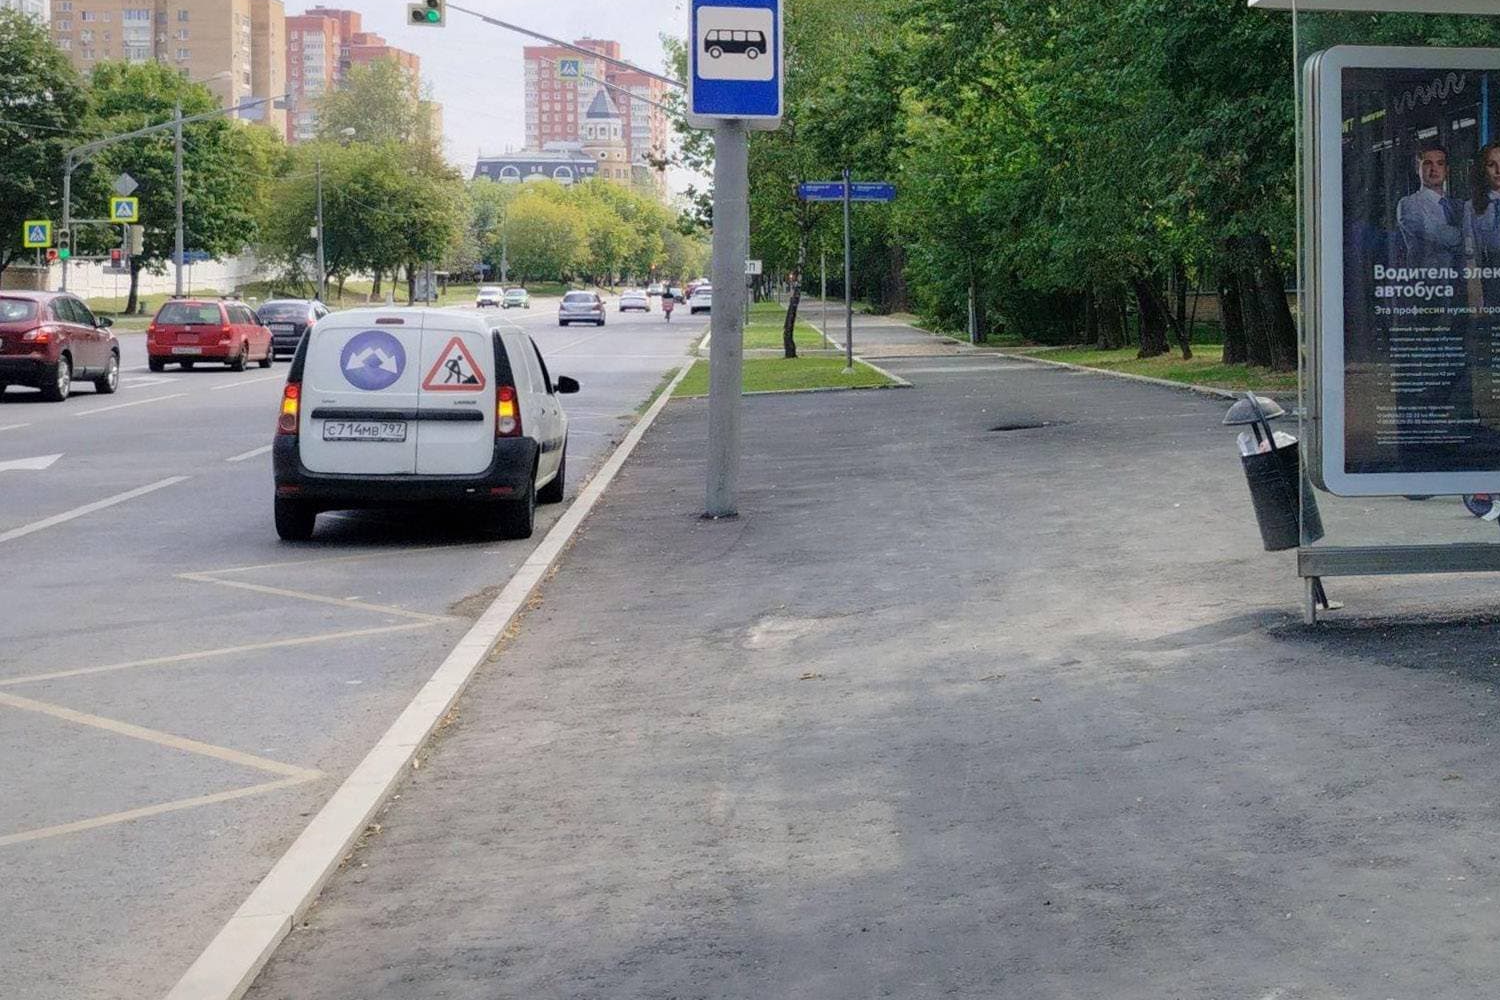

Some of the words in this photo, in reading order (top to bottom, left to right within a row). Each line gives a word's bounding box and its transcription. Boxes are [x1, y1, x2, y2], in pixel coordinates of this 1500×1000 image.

[1373, 264, 1458, 282] Водитель
[1374, 281, 1454, 300] автобуса
[1374, 305, 1391, 315] Эта
[1393, 305, 1445, 316] профессия
[1447, 306, 1477, 316] нужна
